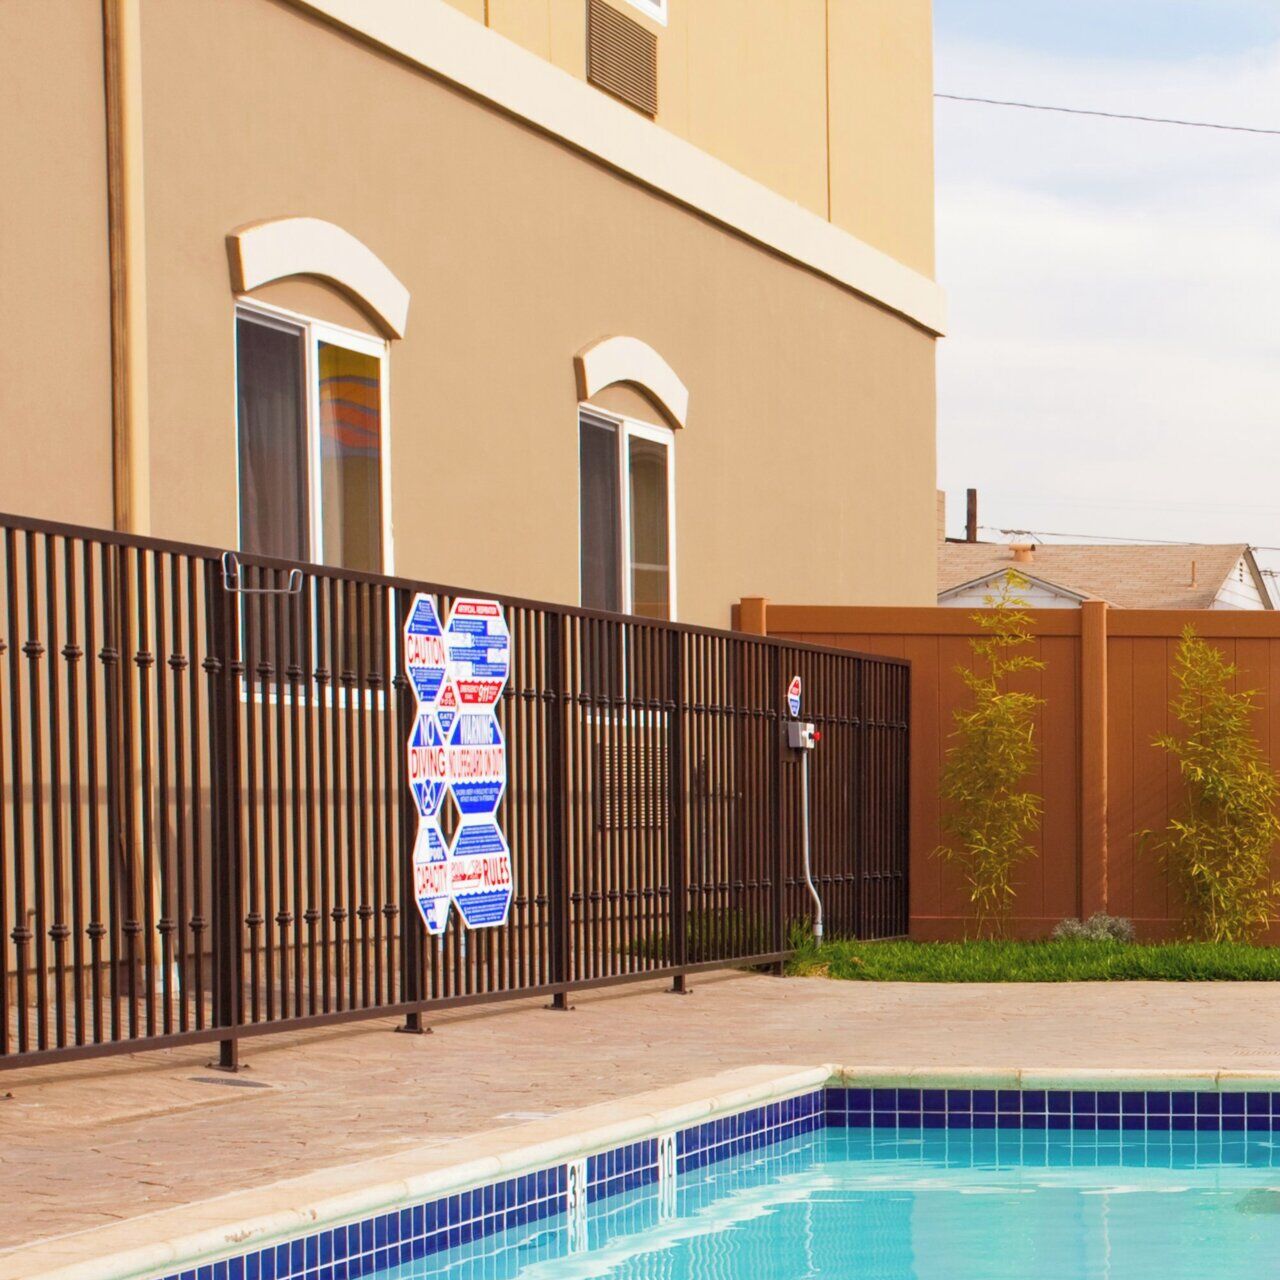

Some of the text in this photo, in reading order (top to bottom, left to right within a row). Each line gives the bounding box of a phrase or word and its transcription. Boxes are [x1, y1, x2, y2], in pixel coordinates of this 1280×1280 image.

[407, 635, 446, 665] CAUTION
[478, 684, 489, 702] 911
[421, 714, 434, 746] NO
[461, 714, 494, 745] WARNING
[412, 748, 446, 777] DIVING
[448, 748, 503, 777] NO LIFEGUARD ON DUTY
[417, 864, 448, 895] CAPACITY
[483, 857, 510, 887] RULES
